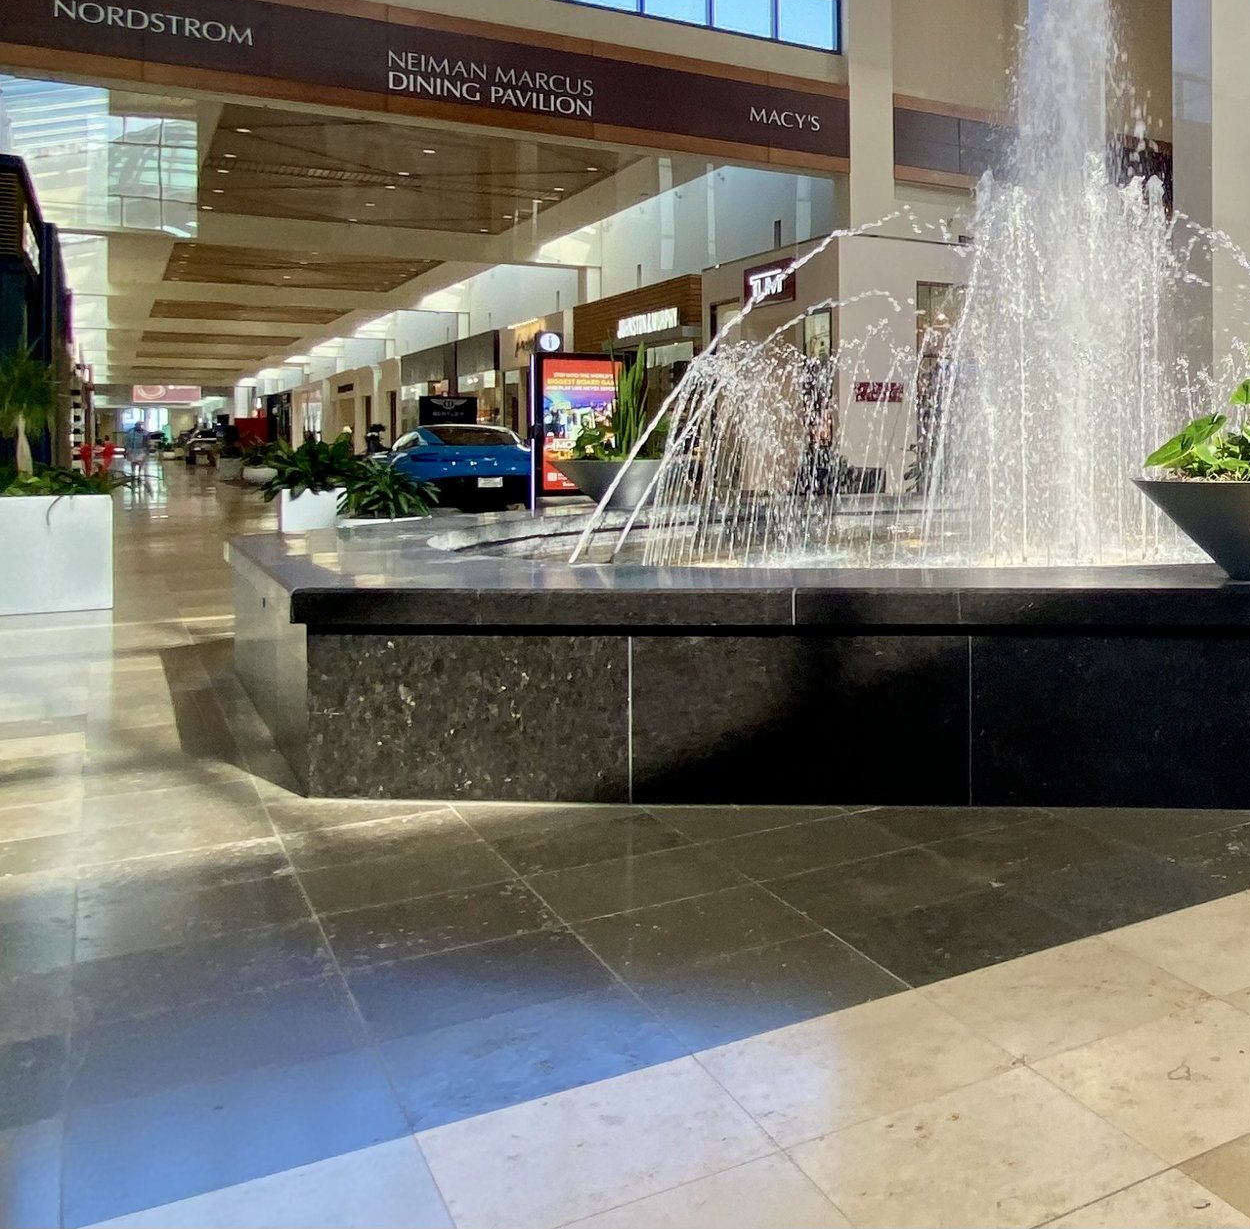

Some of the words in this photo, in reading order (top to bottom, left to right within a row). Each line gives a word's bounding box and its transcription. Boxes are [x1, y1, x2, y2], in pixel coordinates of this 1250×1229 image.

[388, 49, 487, 80] NEIMAN
[494, 66, 594, 97] MARCUS
[388, 71, 481, 101] DINING
[490, 86, 593, 117] PAVILION
[749, 106, 820, 131] MACY'S
